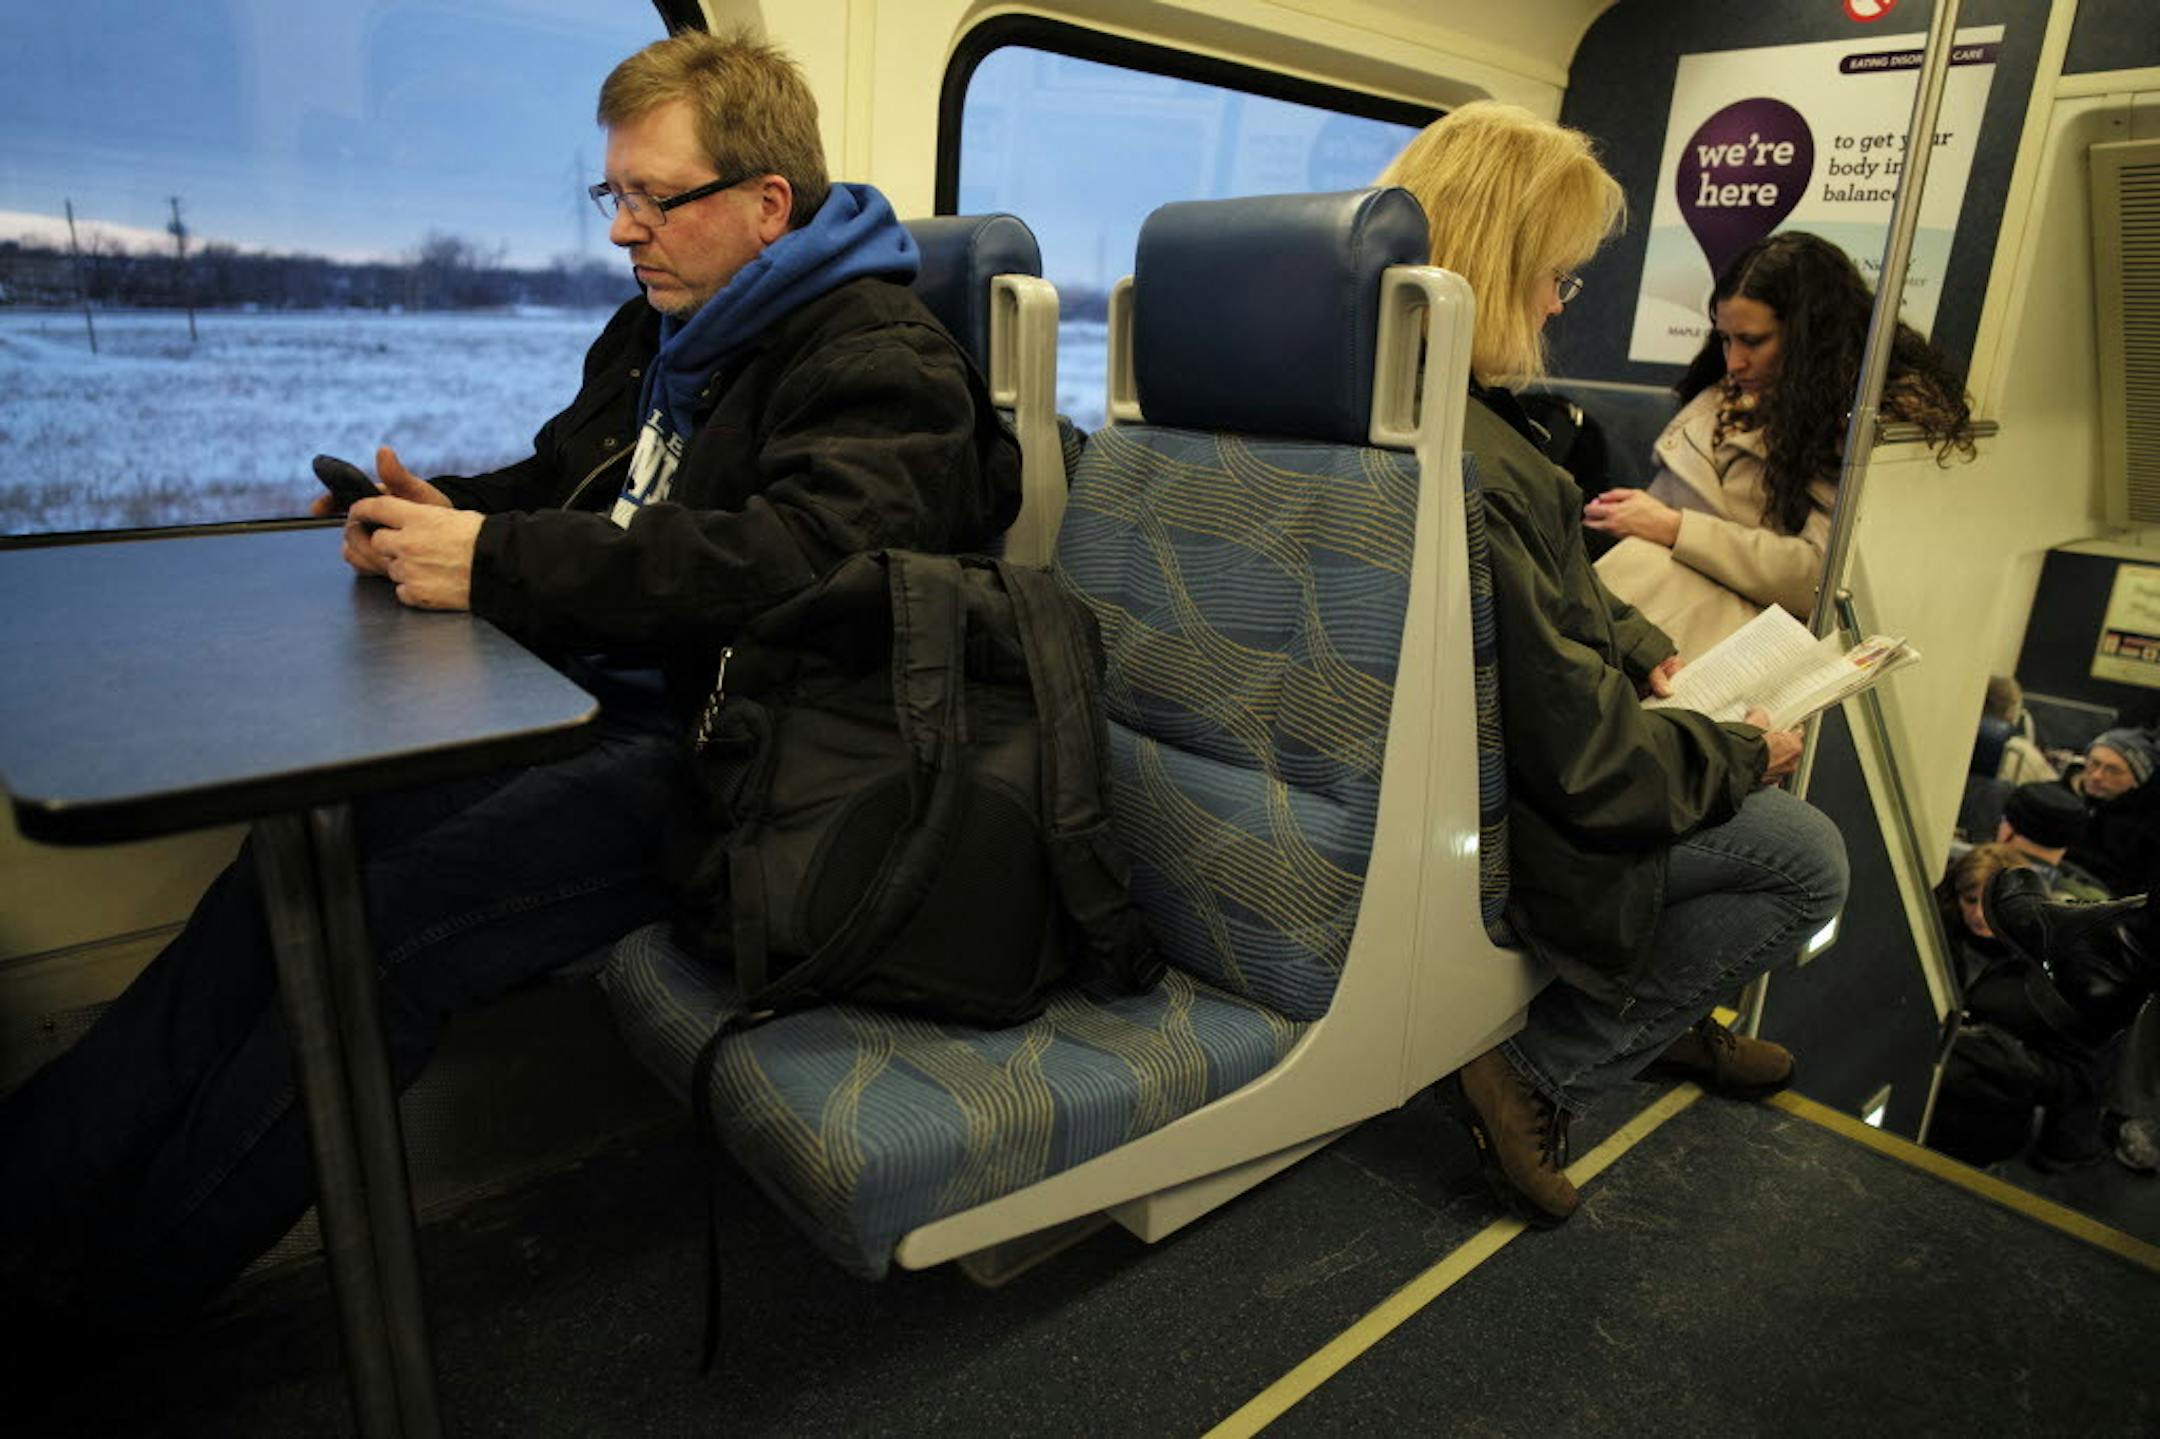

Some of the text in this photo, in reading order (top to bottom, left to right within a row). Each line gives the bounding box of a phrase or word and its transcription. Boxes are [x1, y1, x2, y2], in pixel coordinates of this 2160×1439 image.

[1850, 56, 1889, 70] EATING
[1952, 48, 1985, 61] CARE
[1696, 132, 1795, 168] we're
[1834, 131, 1954, 153] to get yur
[1828, 156, 1880, 180] body
[1695, 171, 1779, 207] here
[1823, 183, 1898, 202] balanc
